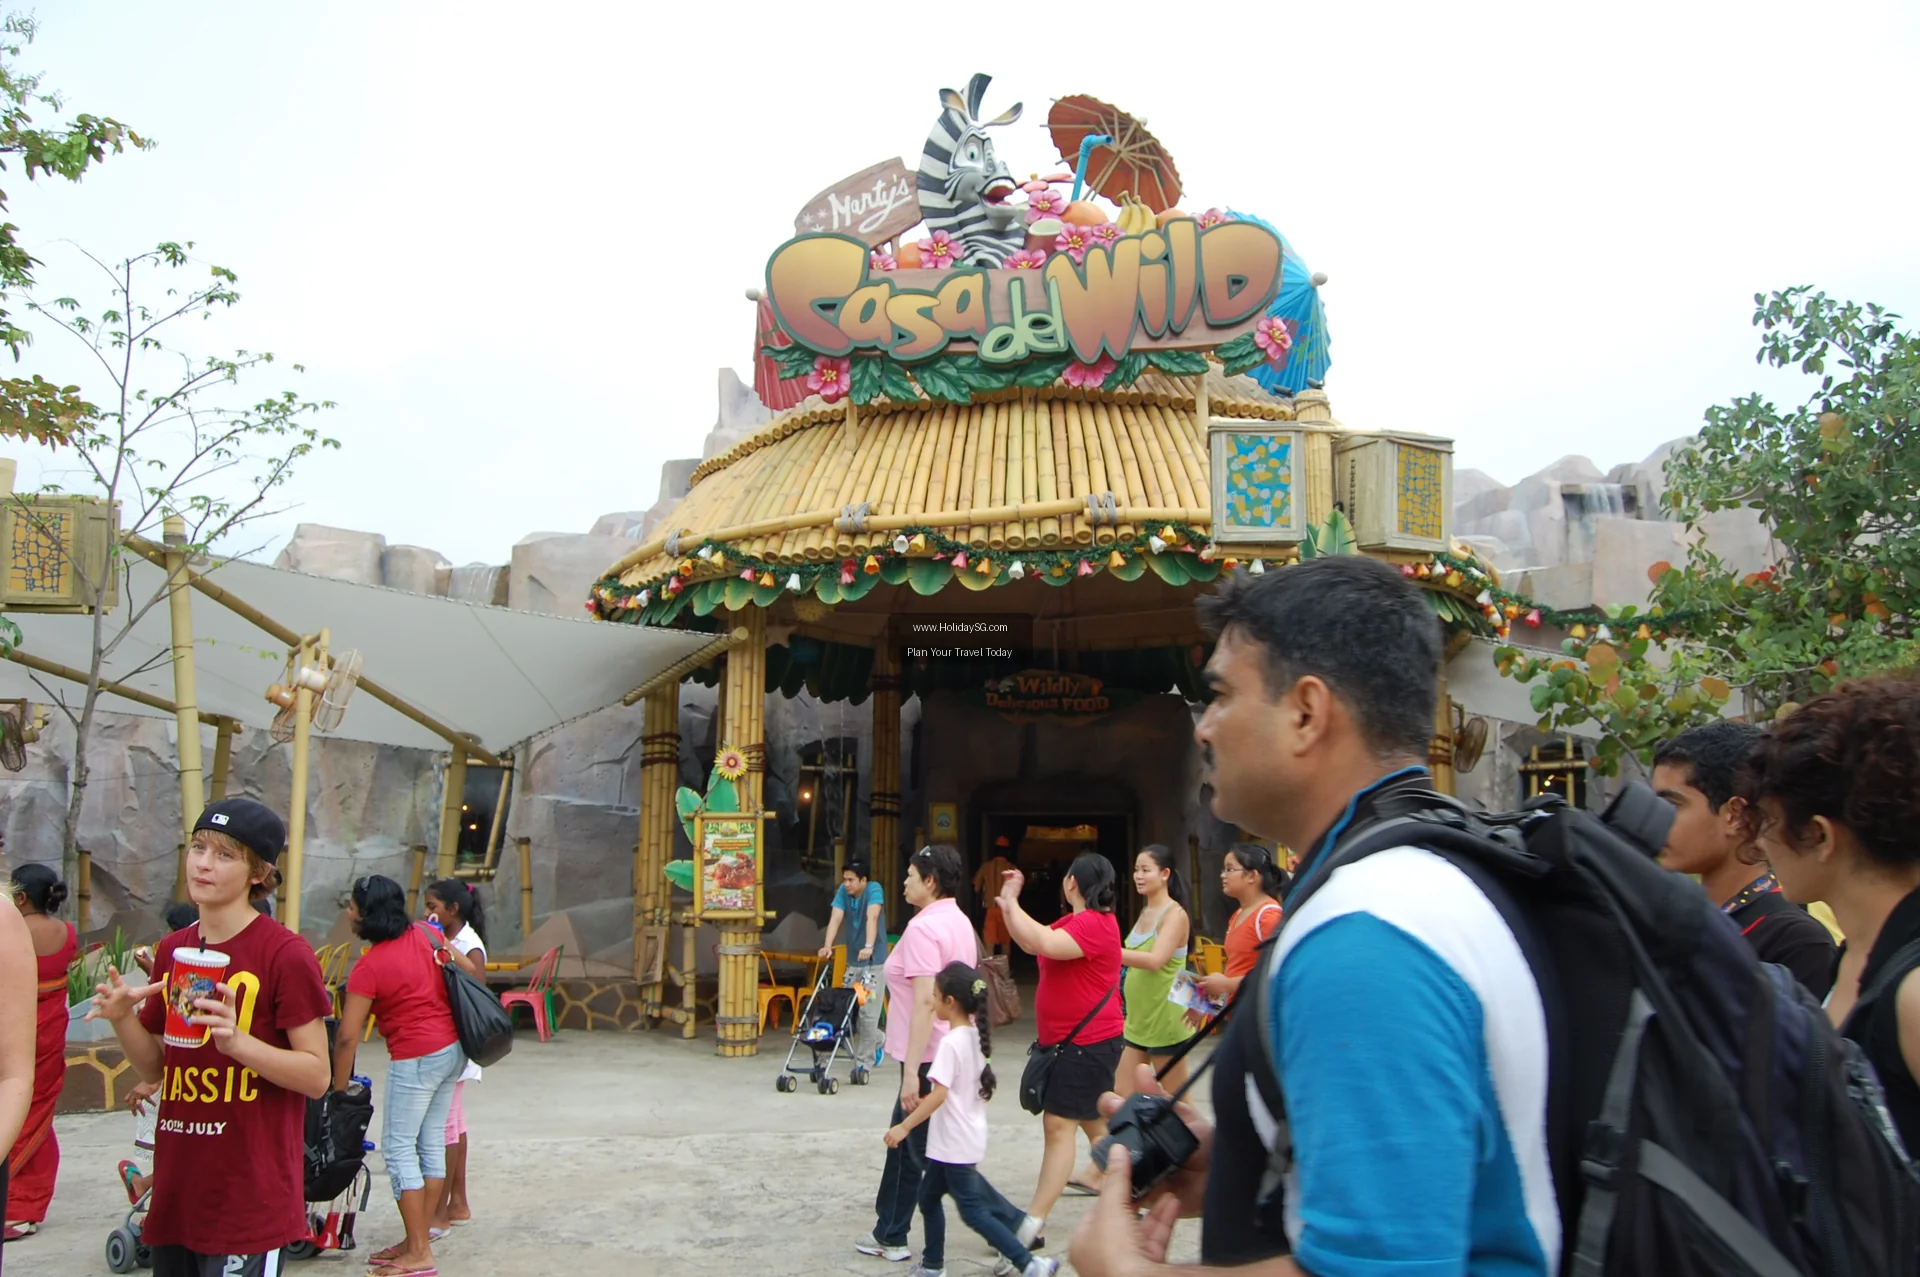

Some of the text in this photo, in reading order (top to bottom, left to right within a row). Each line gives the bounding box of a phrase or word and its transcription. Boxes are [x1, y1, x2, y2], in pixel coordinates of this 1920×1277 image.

[828, 174, 912, 234] Marty's
[767, 233, 989, 360] Casa
[983, 276, 1063, 358] del
[160, 1119, 227, 1135] 20TH JULY
